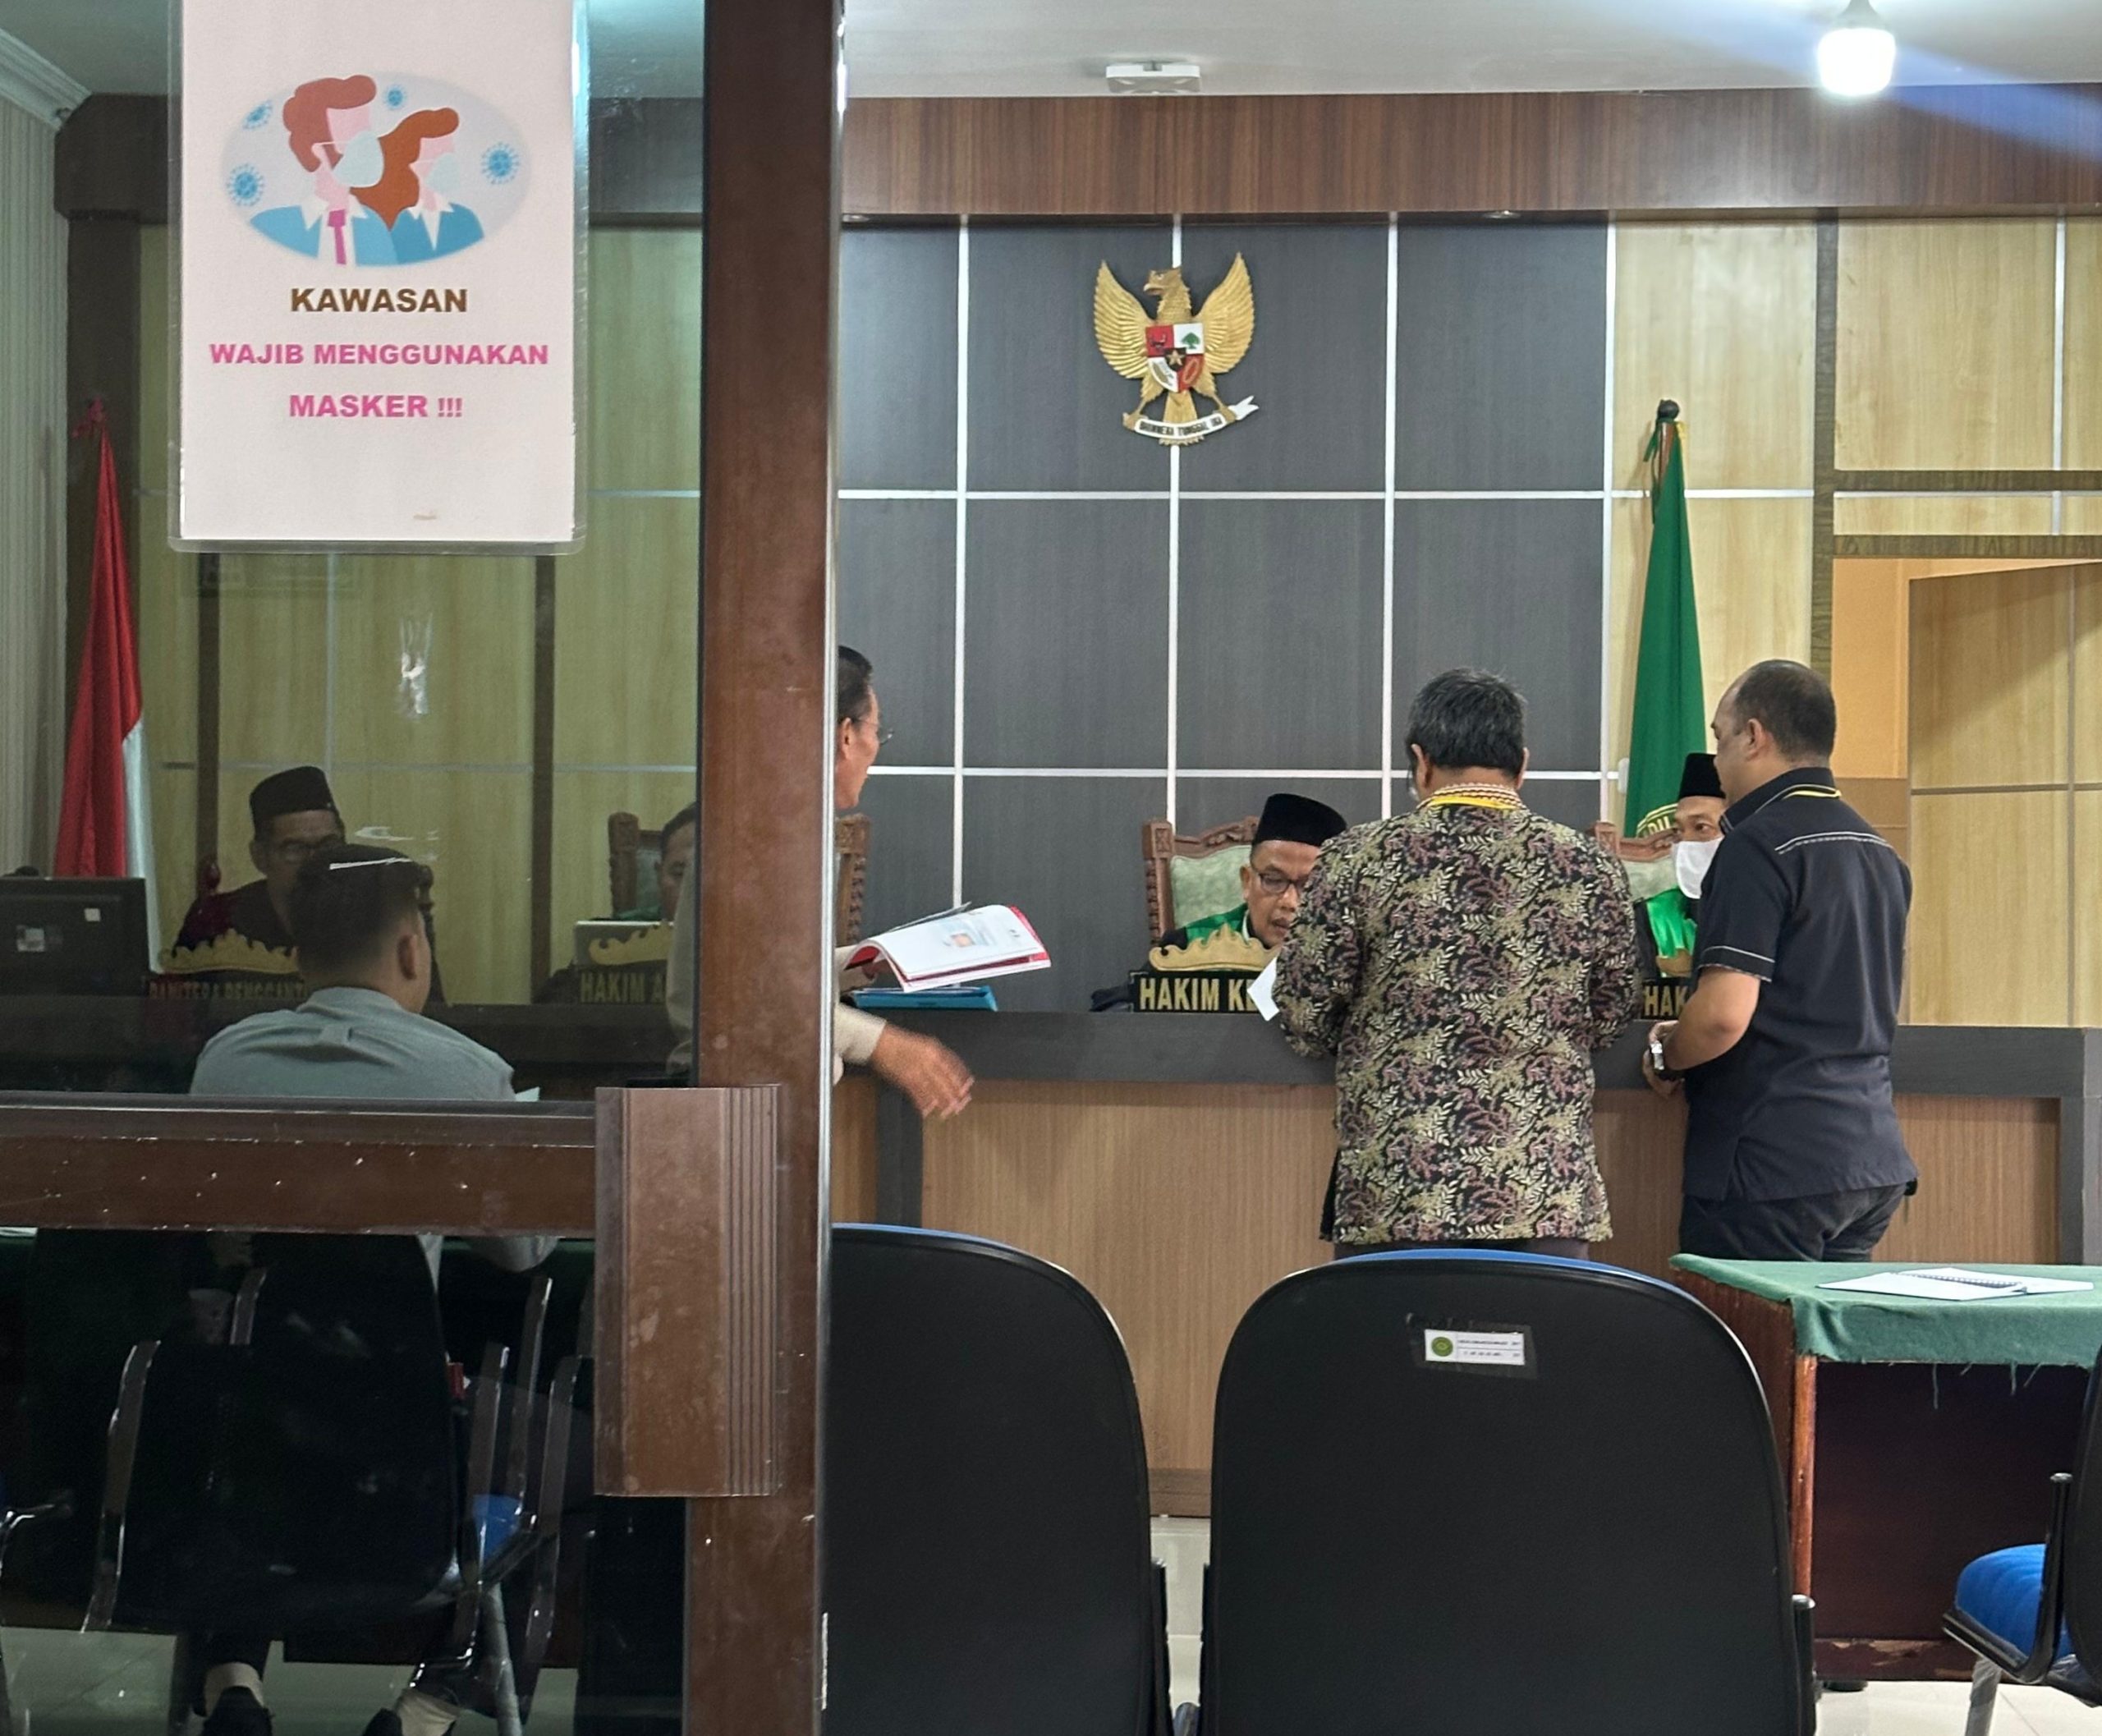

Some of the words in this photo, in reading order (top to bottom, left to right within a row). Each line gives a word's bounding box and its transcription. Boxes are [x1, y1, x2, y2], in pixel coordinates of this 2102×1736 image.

[290, 288, 468, 313] KAWASAN
[209, 343, 304, 365] WAJIB
[314, 344, 549, 365] MENGGUNAKAN
[289, 395, 429, 418] MASKER
[437, 397, 463, 418] !!!
[580, 971, 645, 1003] HAKIM
[1139, 977, 1220, 1011] HAKIM
